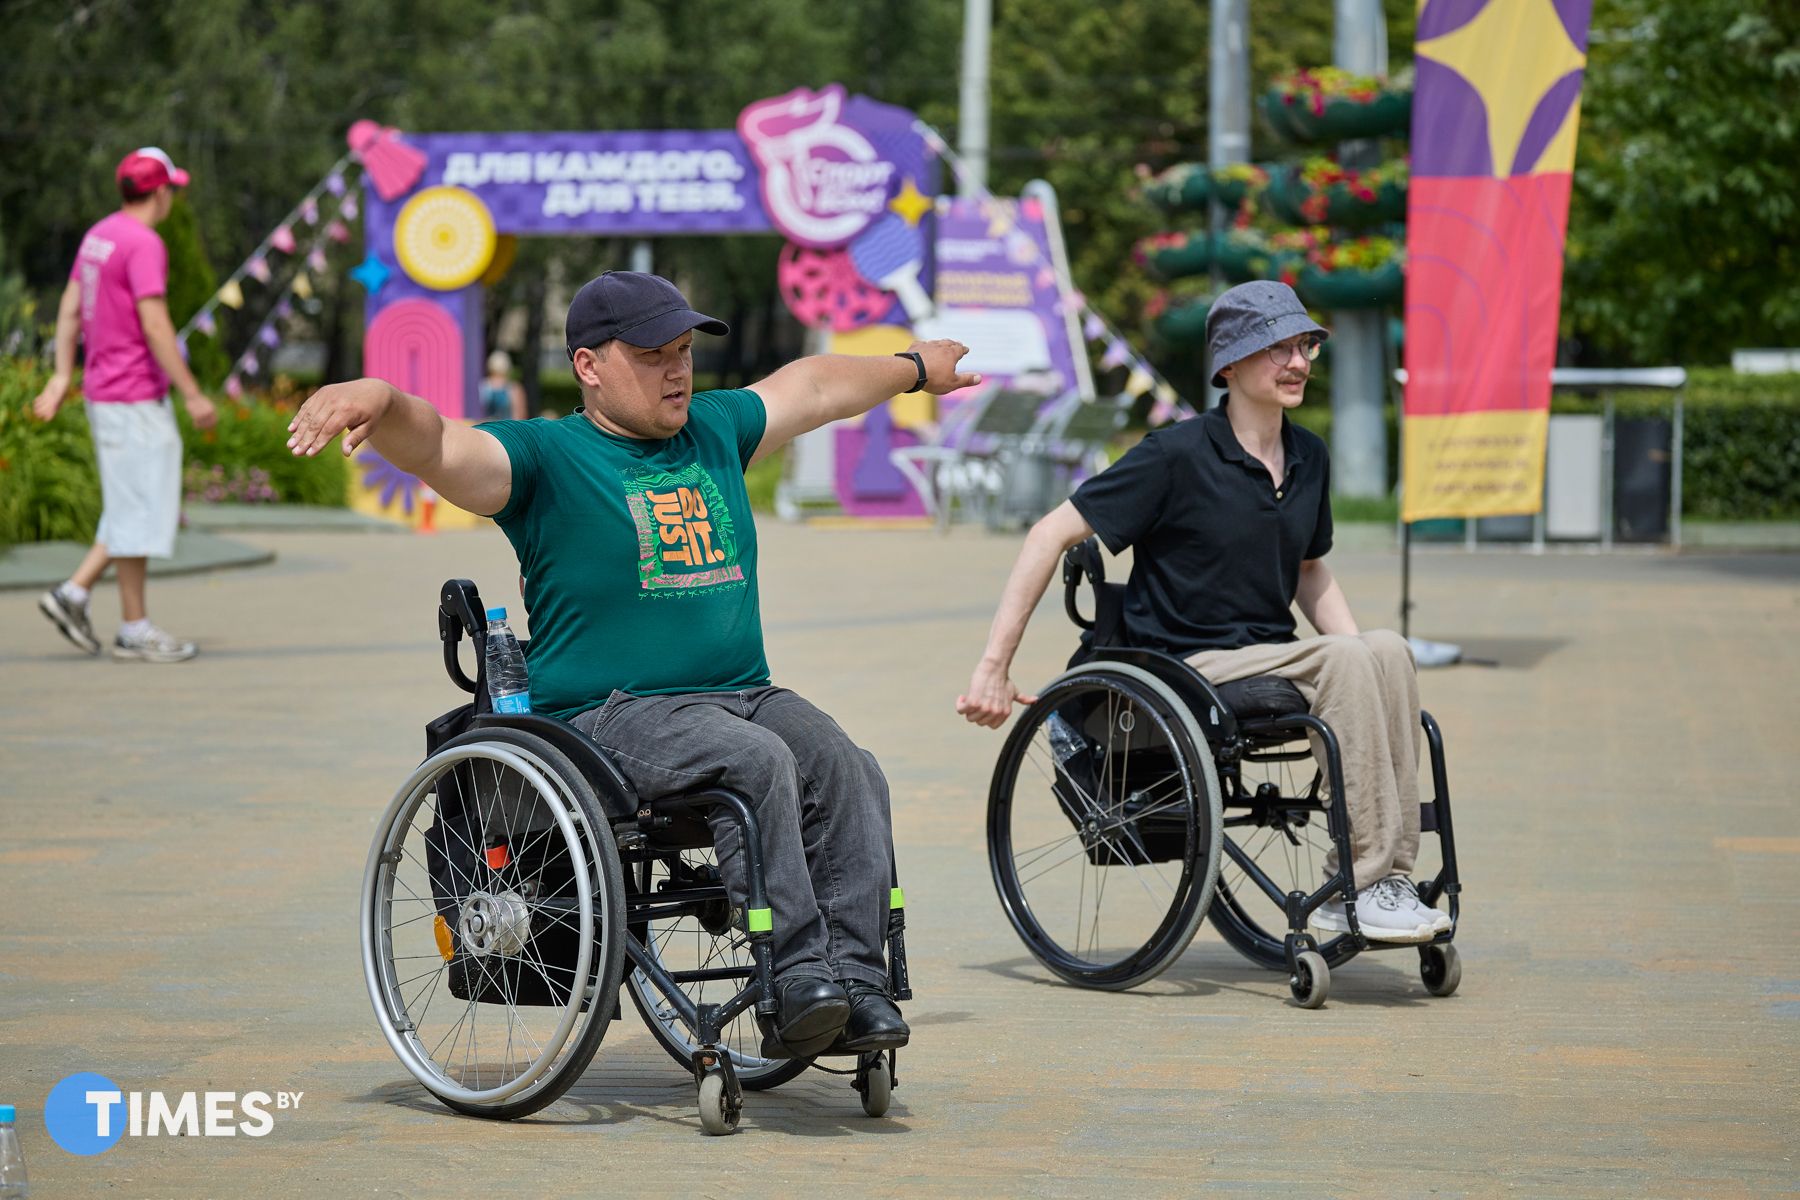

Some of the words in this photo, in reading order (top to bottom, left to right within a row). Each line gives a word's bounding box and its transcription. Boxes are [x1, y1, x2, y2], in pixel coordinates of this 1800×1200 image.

[443, 151, 530, 188] ДЛЯ
[543, 182, 634, 217] ДЛЯ
[635, 181, 745, 213] ТЕБЯ.
[677, 487, 708, 519] DO
[646, 489, 693, 566] JUST
